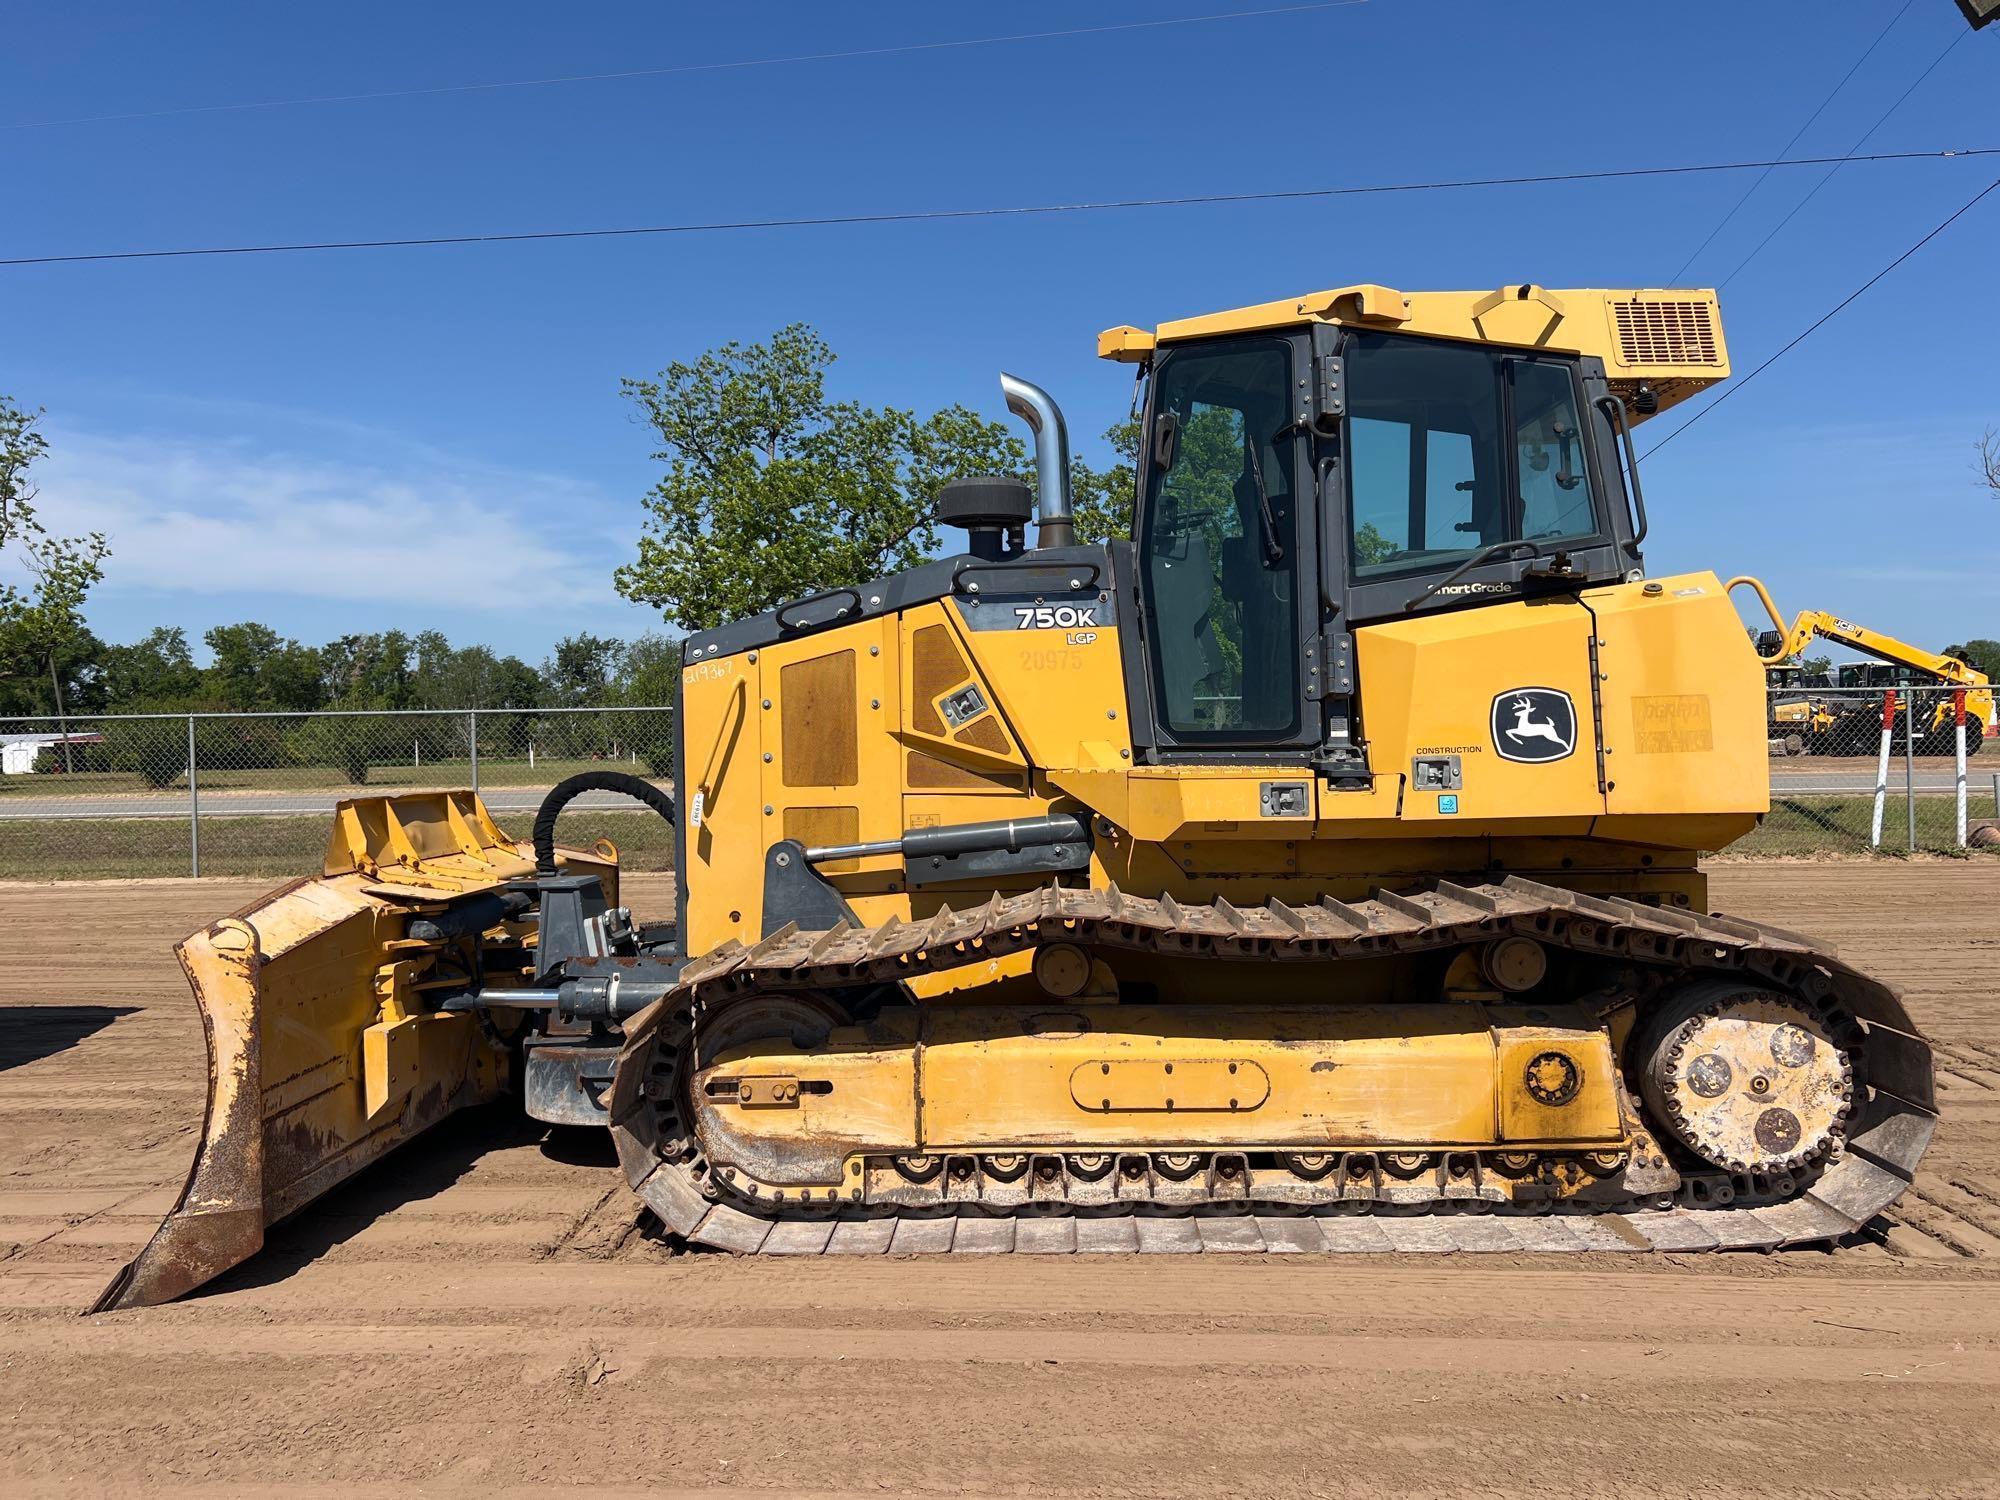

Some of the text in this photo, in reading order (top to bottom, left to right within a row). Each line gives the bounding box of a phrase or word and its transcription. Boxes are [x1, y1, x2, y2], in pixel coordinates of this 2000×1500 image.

[1015, 606, 1097, 629] 750K
[1833, 619, 1856, 632] JCB
[1067, 633, 1097, 645] LGP
[1416, 746, 1482, 755] CONSTRUCTION
